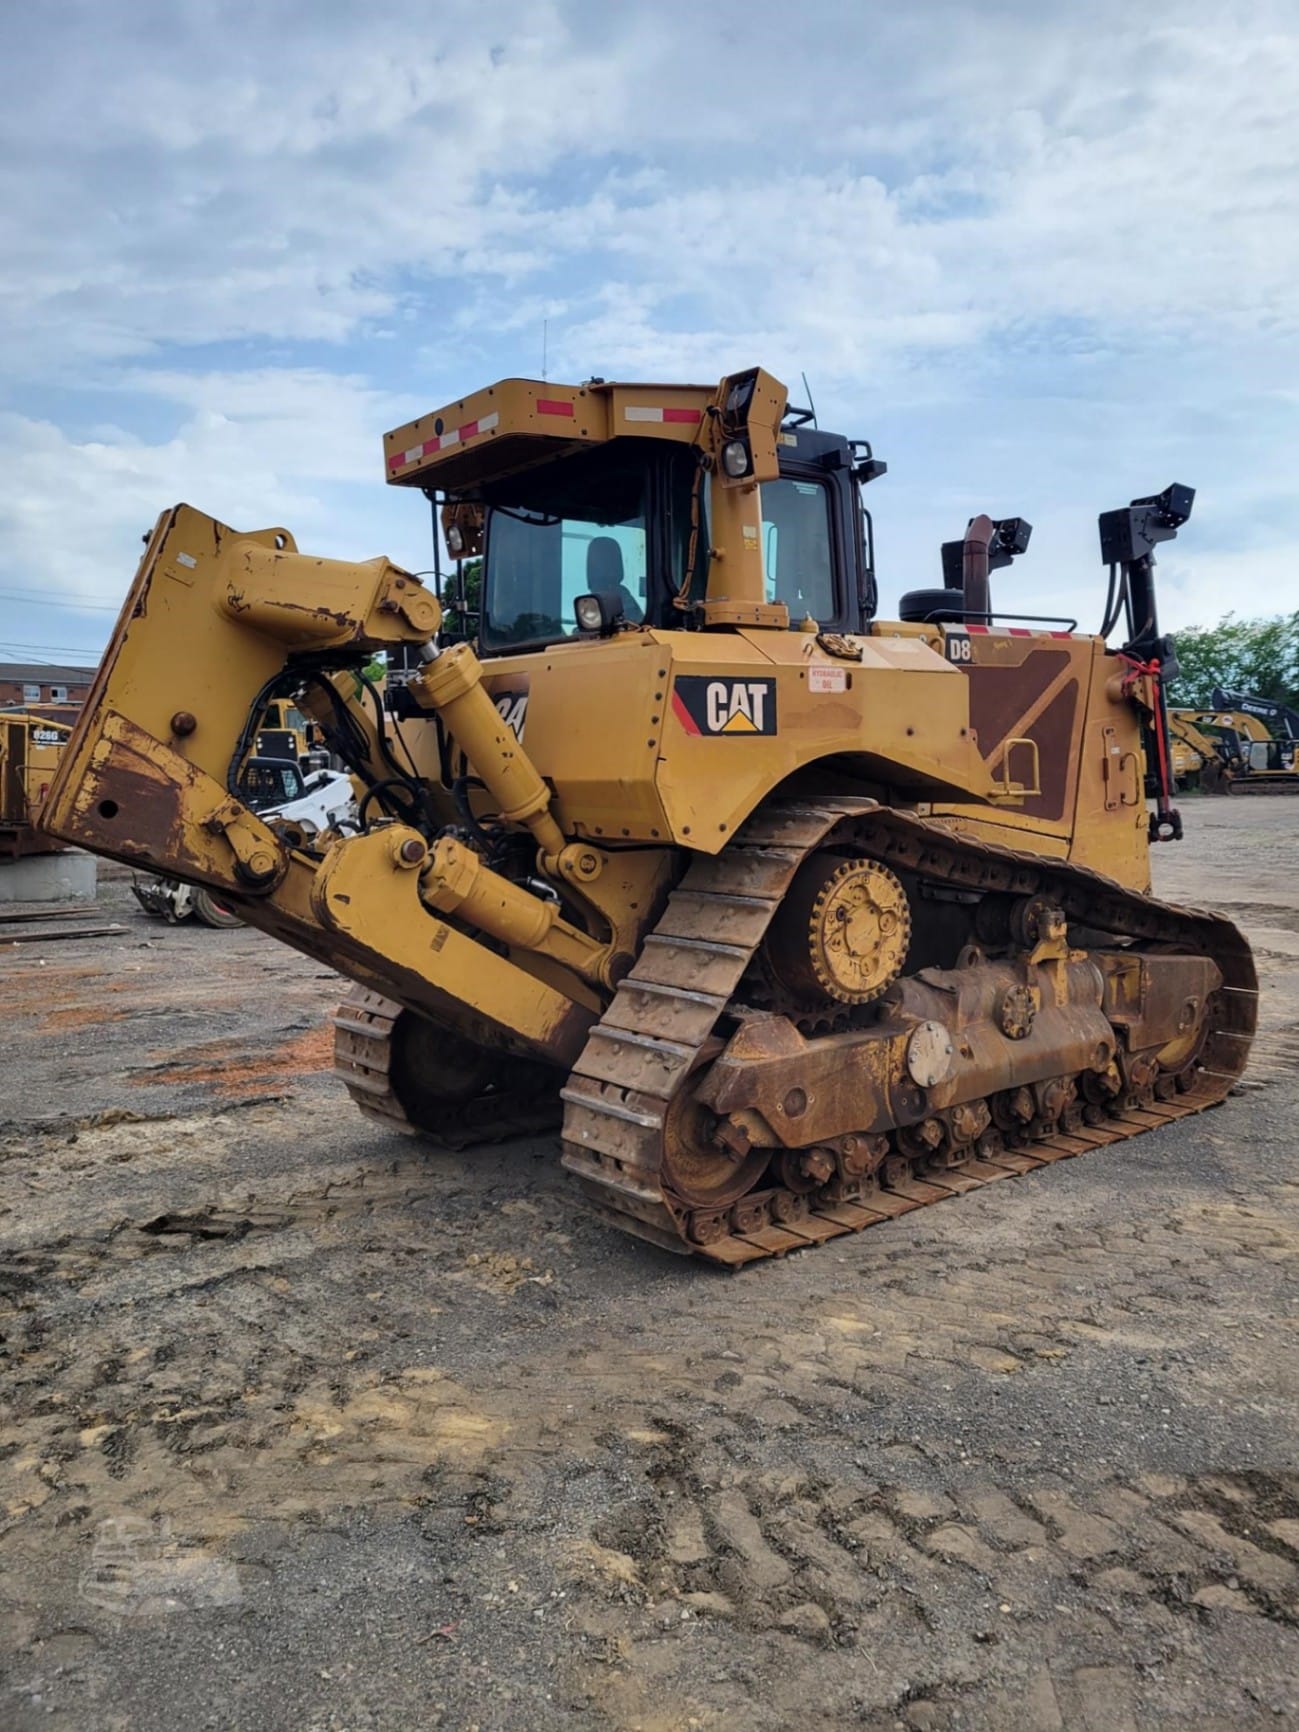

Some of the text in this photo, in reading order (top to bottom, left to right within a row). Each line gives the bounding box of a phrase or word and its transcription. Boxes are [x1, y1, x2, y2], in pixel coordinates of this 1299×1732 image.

[950, 639, 971, 661] D8
[495, 697, 529, 744] CA
[706, 682, 768, 732] CAT
[1241, 703, 1268, 715] DEERE
